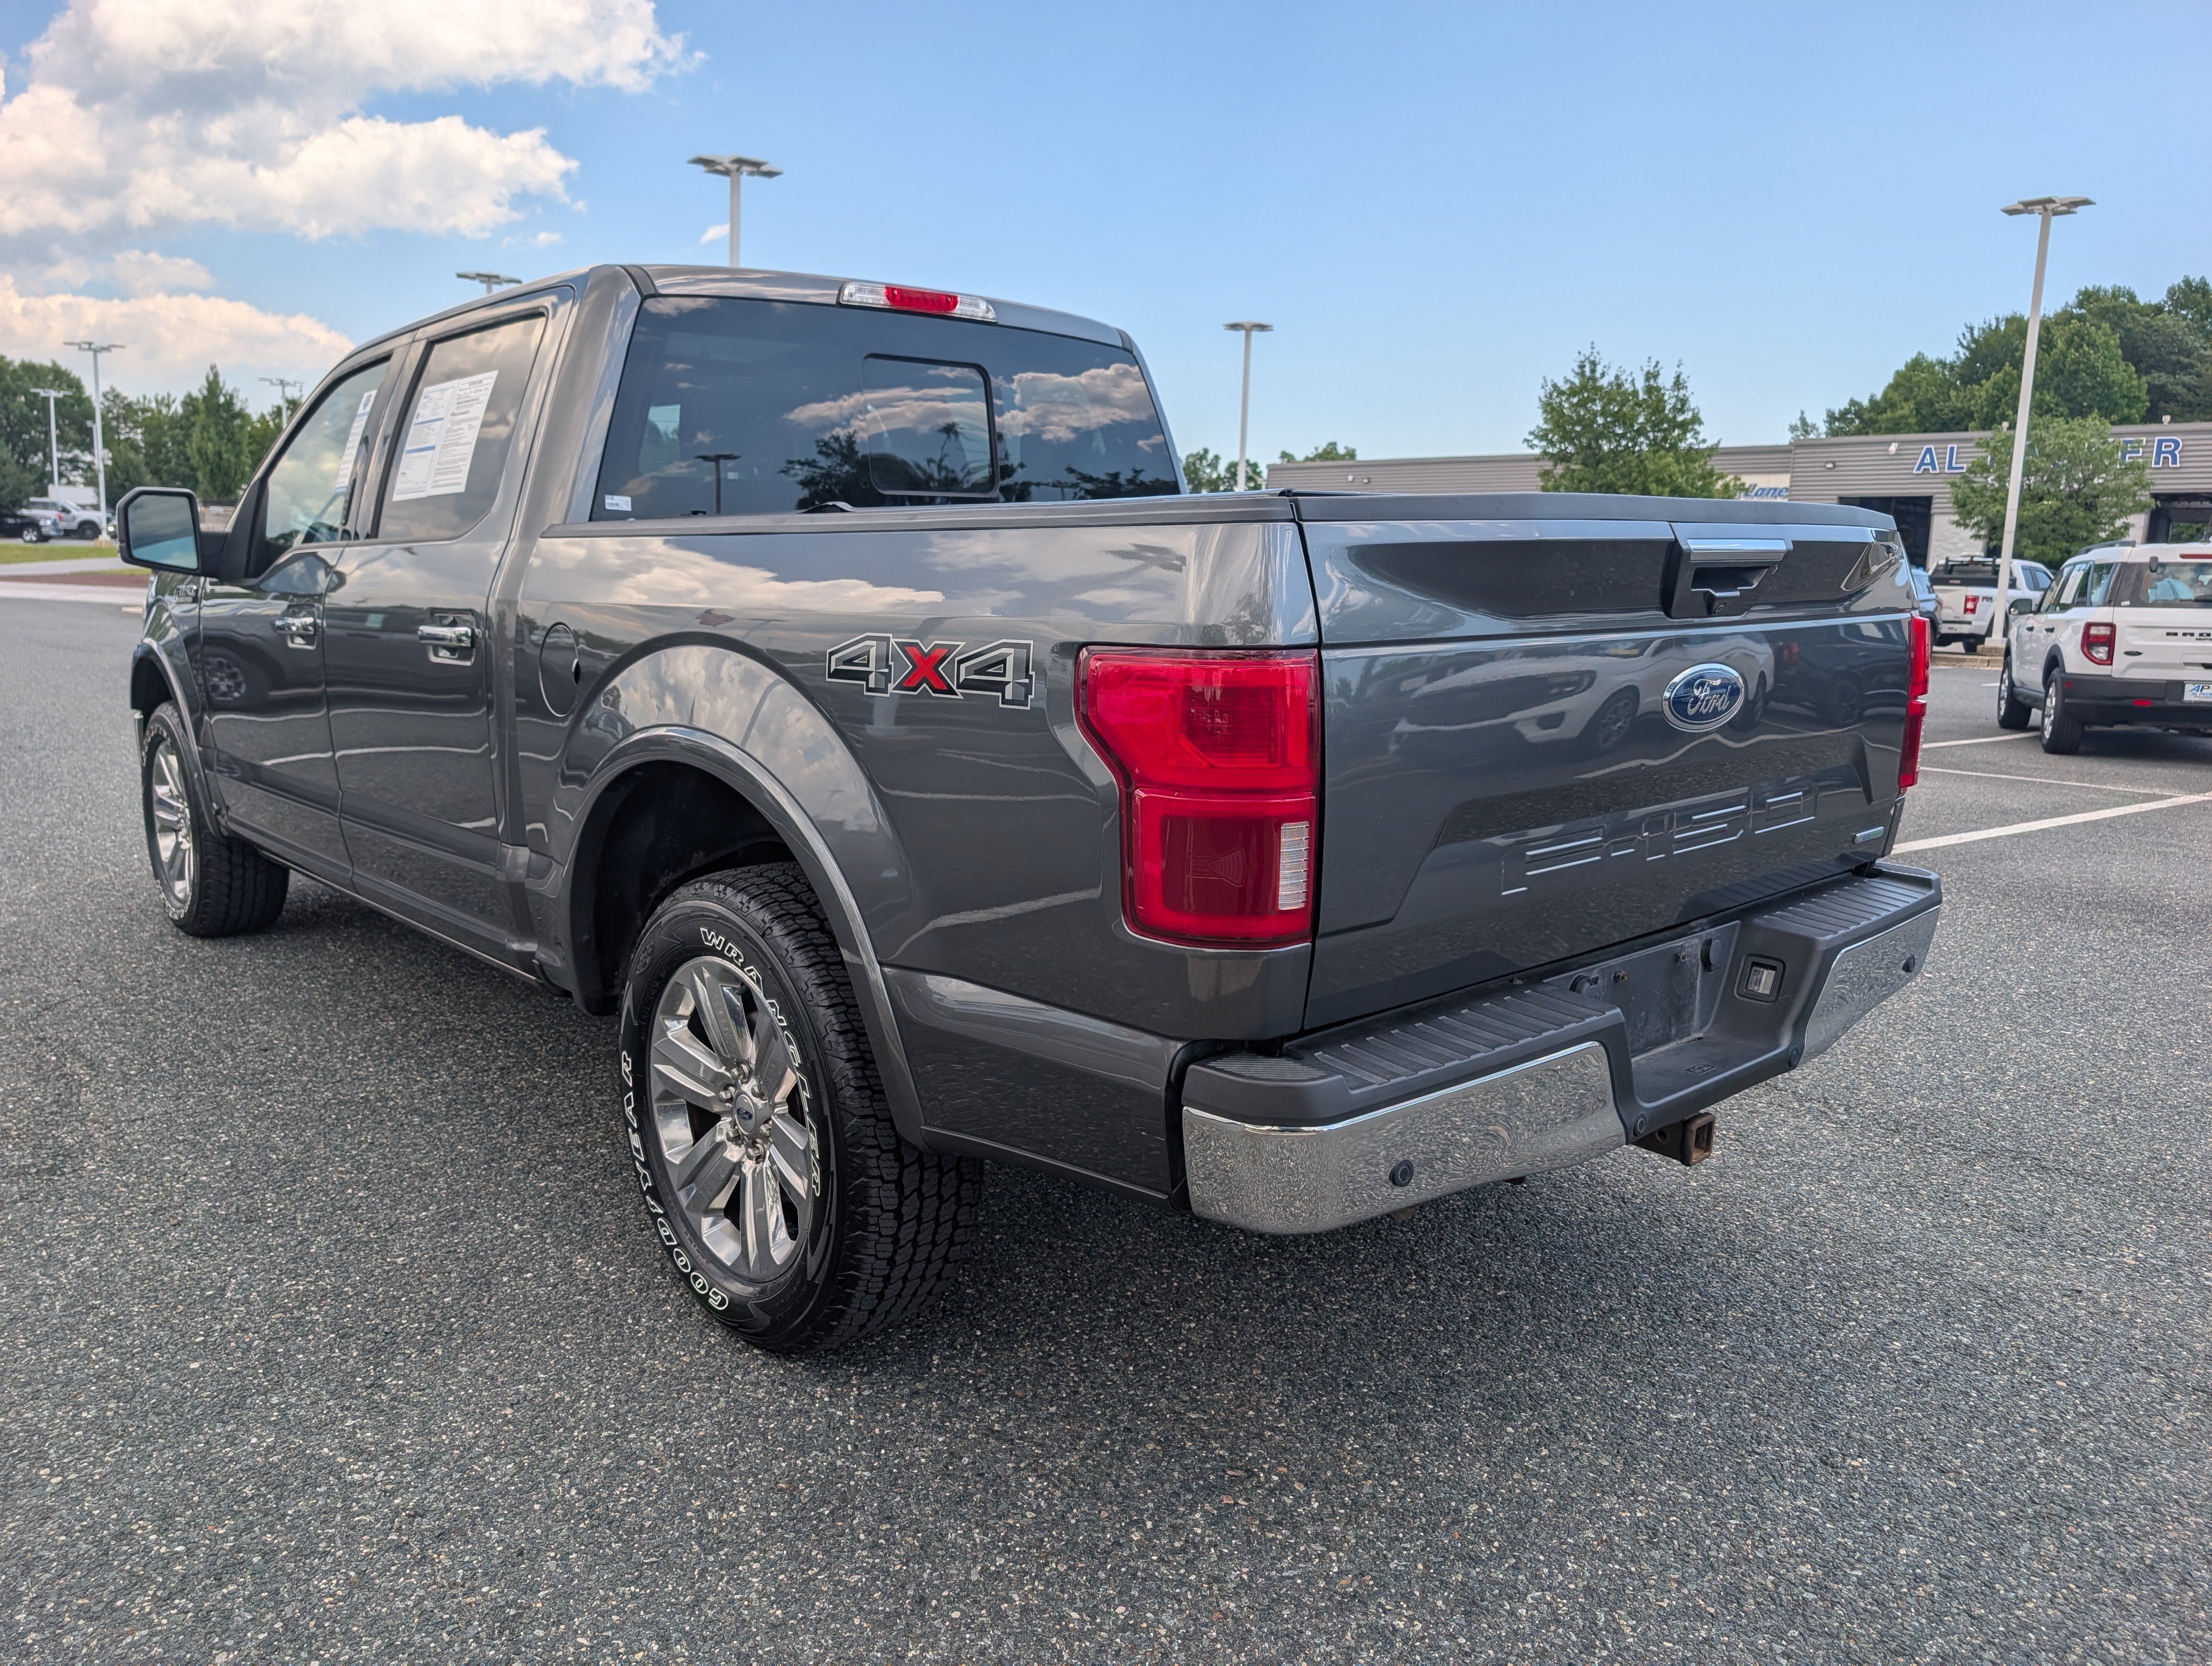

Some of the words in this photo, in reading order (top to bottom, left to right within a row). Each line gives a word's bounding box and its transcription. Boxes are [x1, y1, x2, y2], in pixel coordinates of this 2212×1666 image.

[1913, 444, 1967, 474] AL
[1687, 678, 1732, 716] Ford
[700, 927, 821, 1197] WRANGLER
[620, 1050, 729, 1310] GOODYEAR
